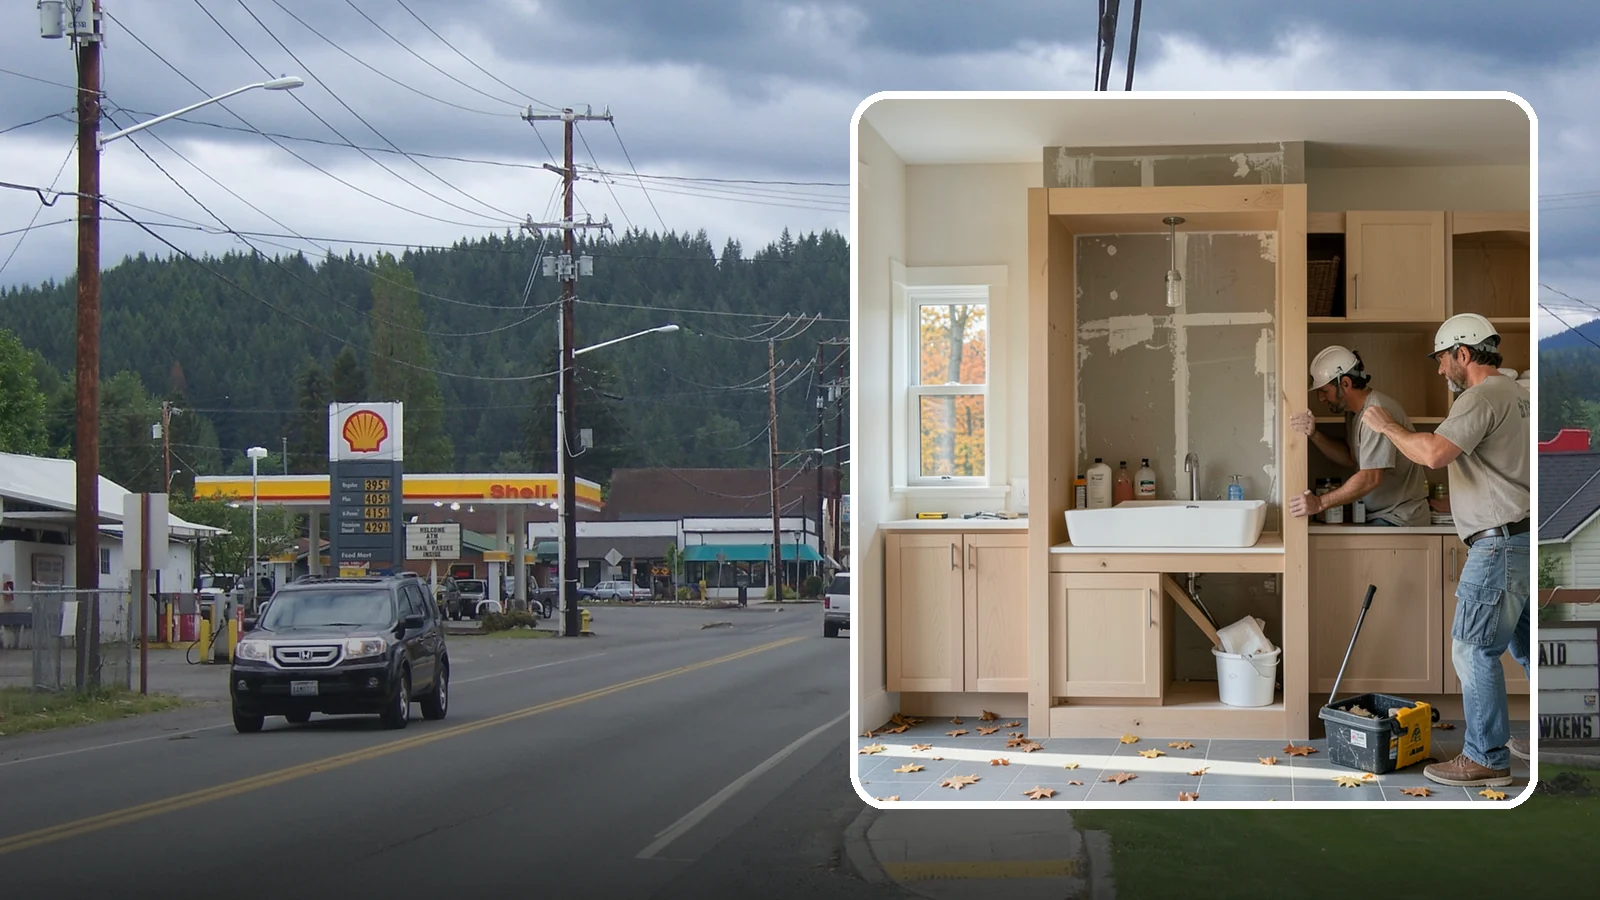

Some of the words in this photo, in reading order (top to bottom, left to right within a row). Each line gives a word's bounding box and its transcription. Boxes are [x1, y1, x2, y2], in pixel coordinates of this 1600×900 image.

[366, 480, 383, 490] 395
[490, 484, 547, 499] Shell
[366, 494, 383, 504] 405
[366, 508, 383, 518] 415
[366, 522, 383, 533] 429
